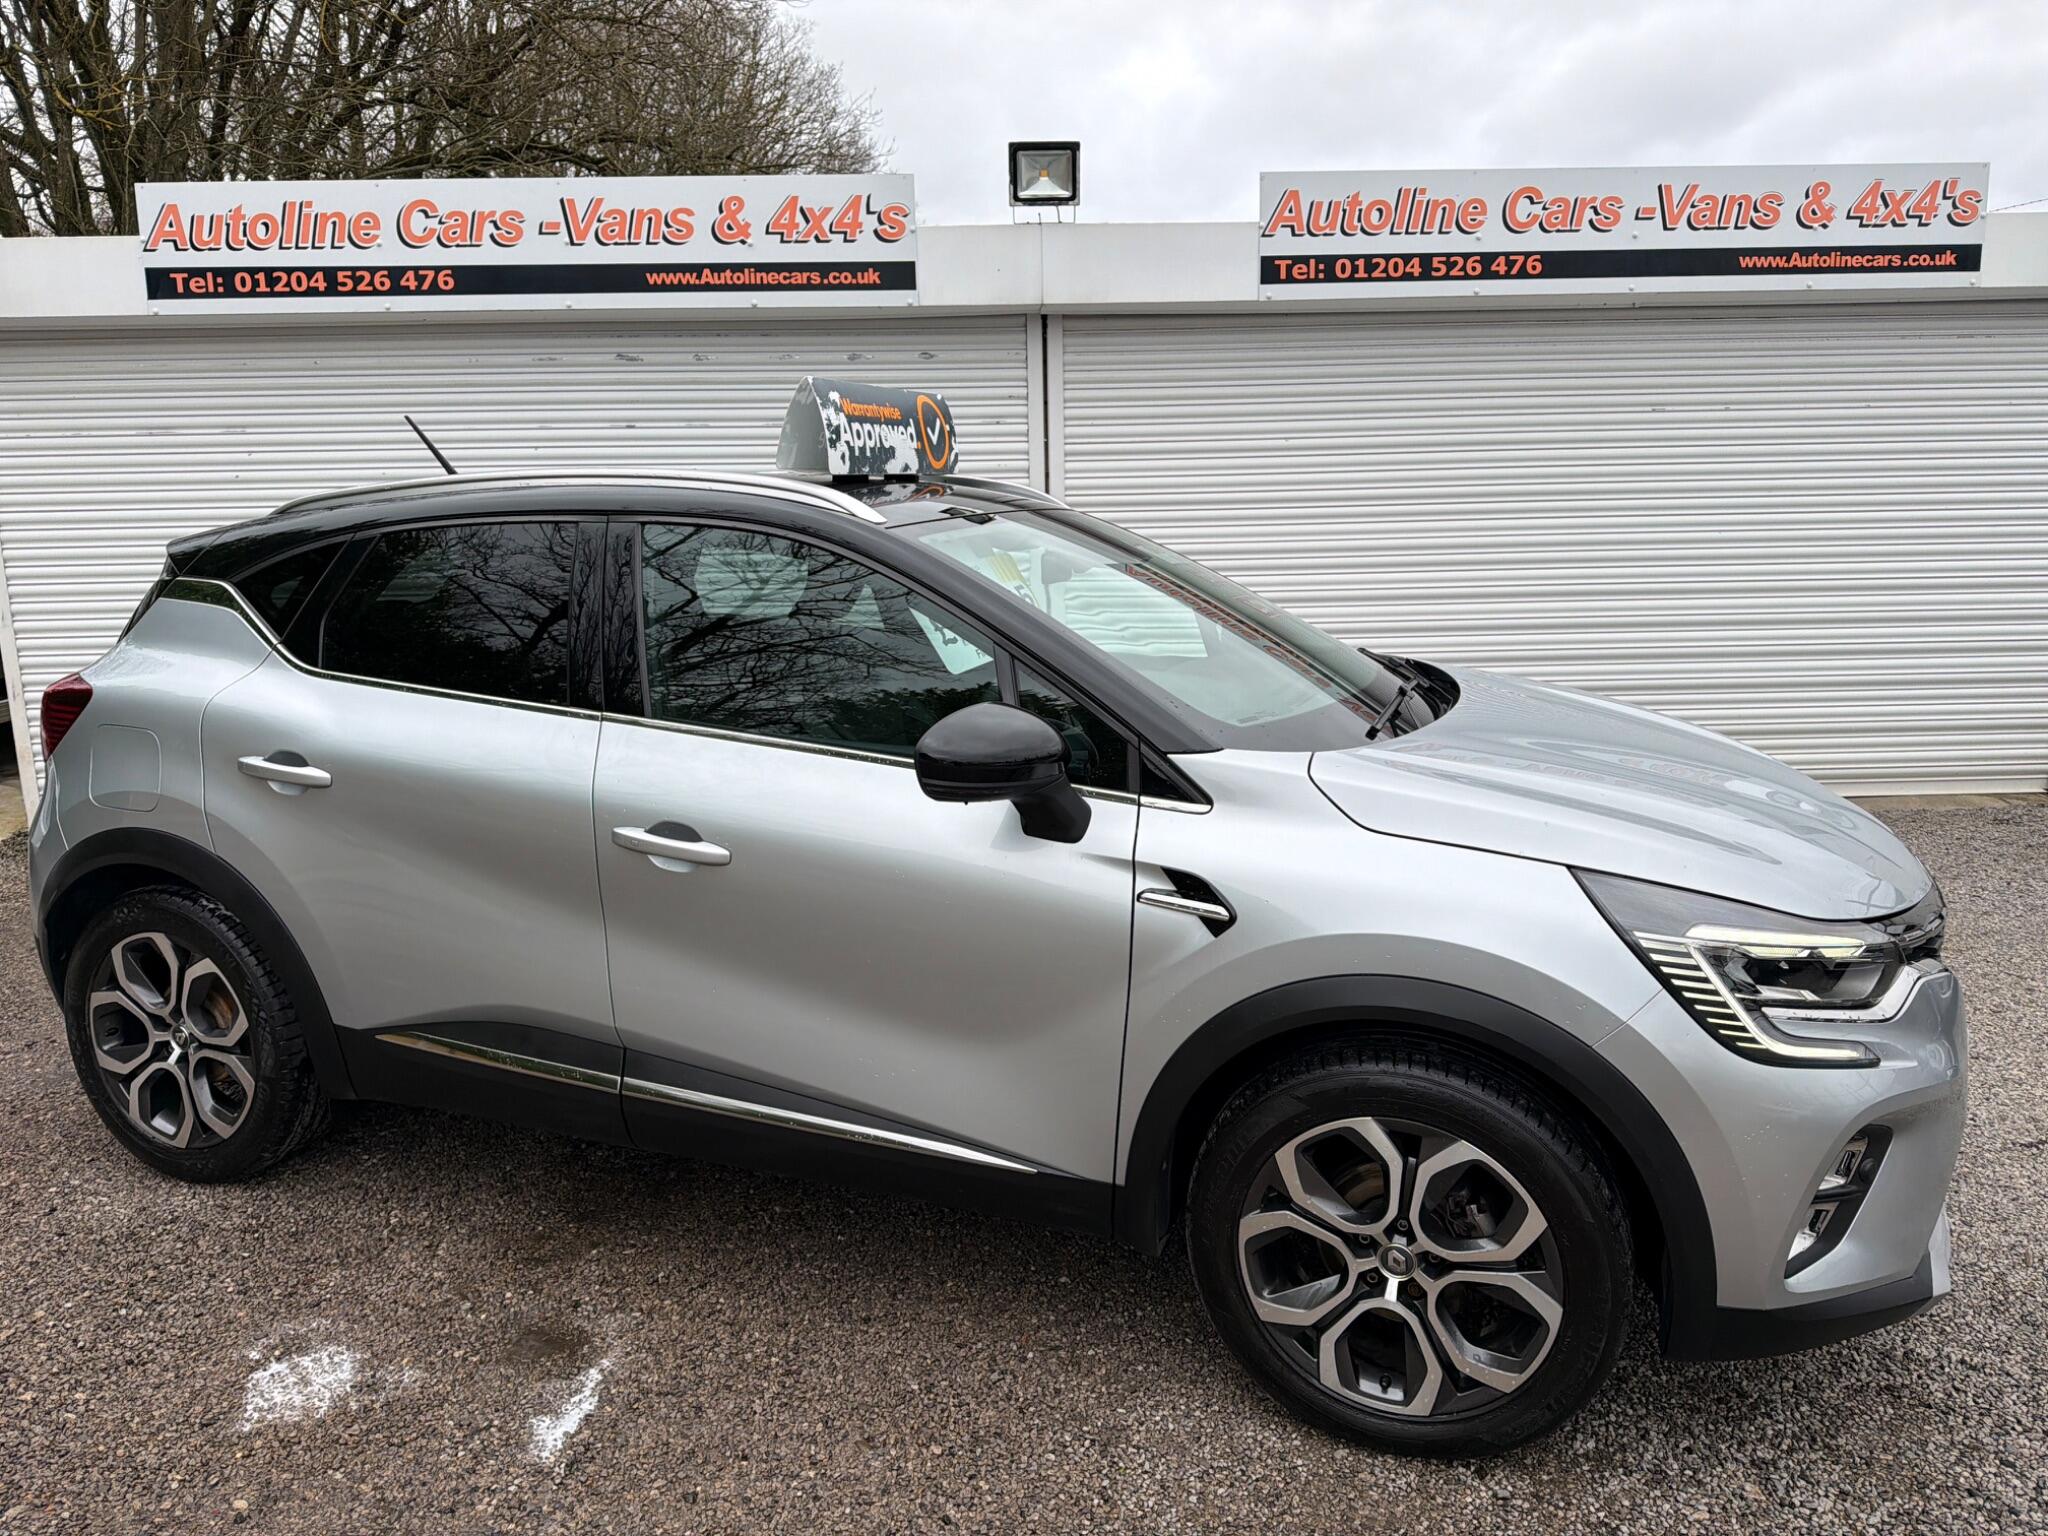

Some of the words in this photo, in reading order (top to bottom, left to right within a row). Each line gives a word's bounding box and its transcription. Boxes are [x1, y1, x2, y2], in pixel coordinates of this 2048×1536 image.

[143, 200, 382, 252] Autoline
[396, 198, 525, 249] Cars
[711, 194, 754, 246] &
[765, 193, 911, 245] 4x4's
[1260, 187, 1489, 238] Autoline
[1502, 185, 1624, 234] Cars
[1796, 180, 1838, 230] &
[1846, 178, 1984, 229] 4x4's
[169, 272, 225, 294] Tel:
[234, 270, 328, 293] 01204
[336, 269, 392, 292] 526
[399, 268, 456, 291] 476
[1274, 258, 1326, 279] Tel:
[1334, 256, 1422, 279] 01204
[1431, 255, 1482, 277] 526
[1490, 254, 1543, 276] 476
